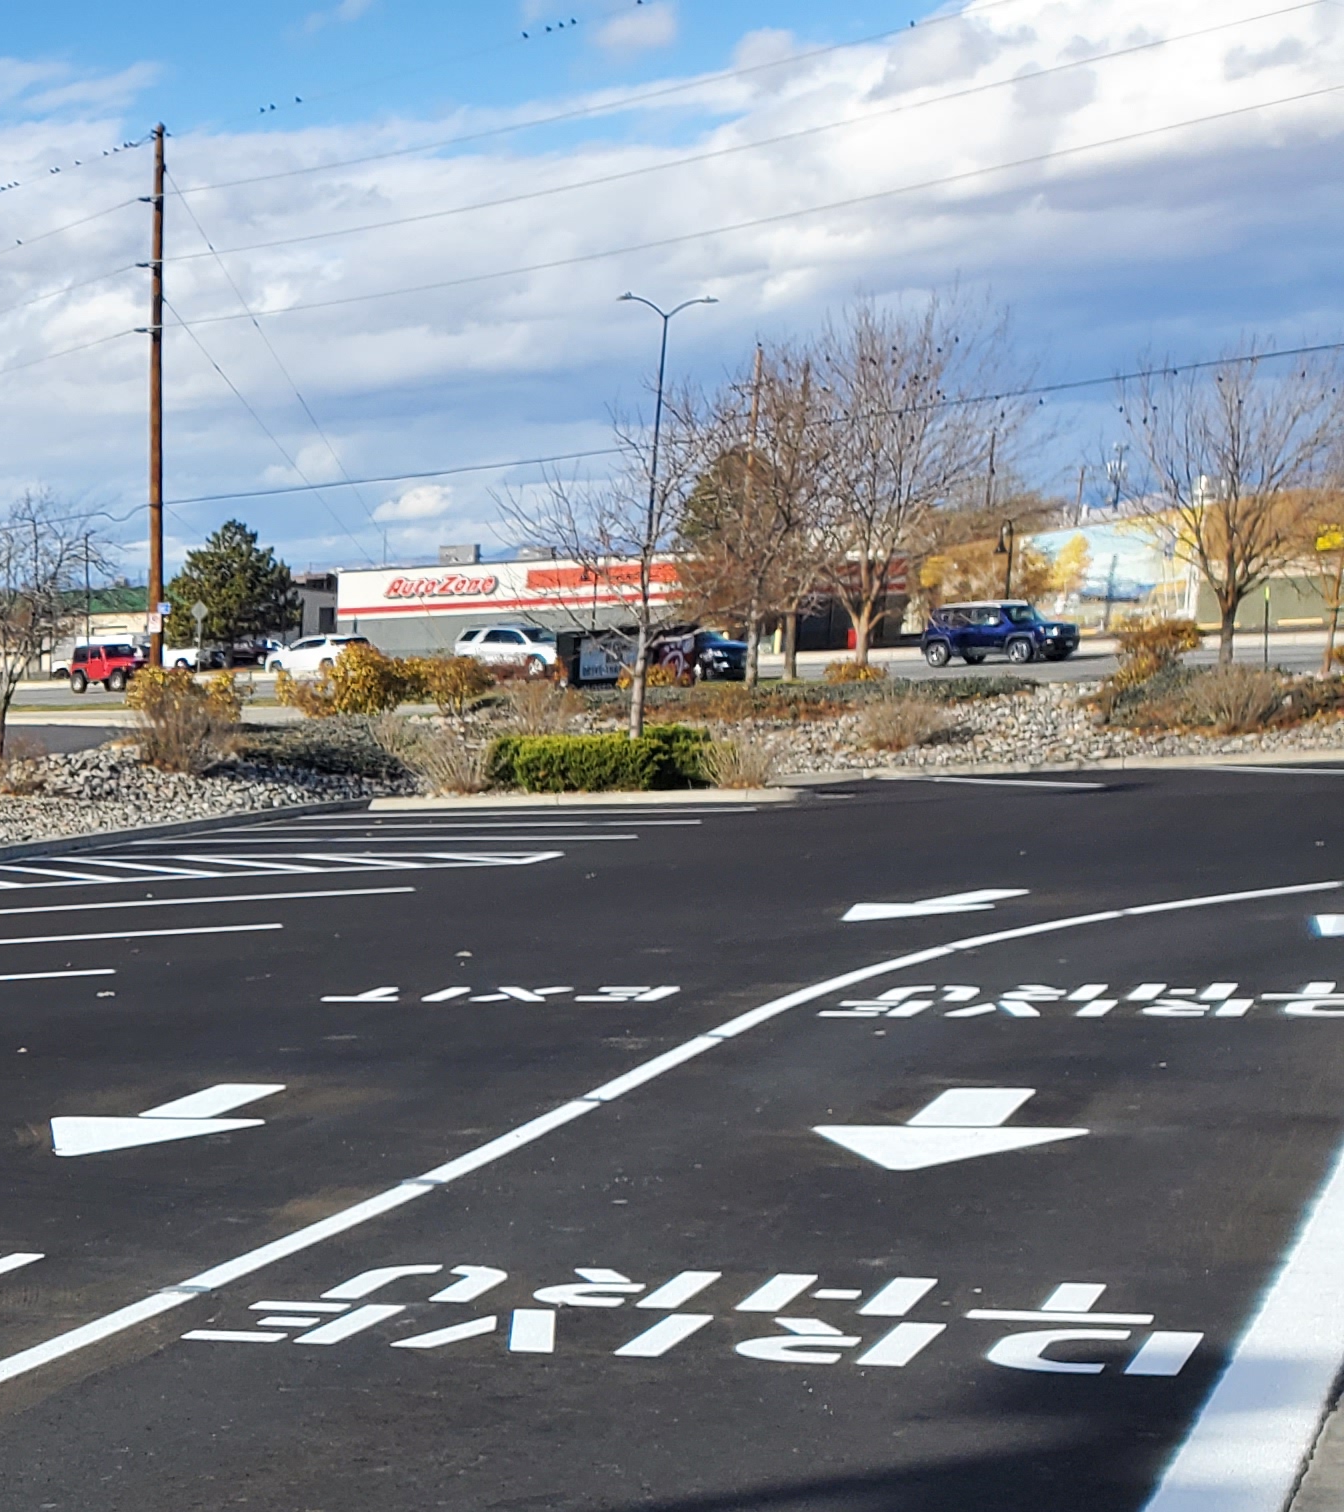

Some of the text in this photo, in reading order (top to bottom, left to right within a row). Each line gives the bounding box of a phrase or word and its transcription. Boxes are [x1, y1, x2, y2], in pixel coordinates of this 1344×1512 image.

[385, 573, 500, 599] AutoZone
[320, 986, 681, 1002] EXIT
[320, 1264, 1155, 1325] THRU
[179, 1301, 1206, 1377] DRIVE
